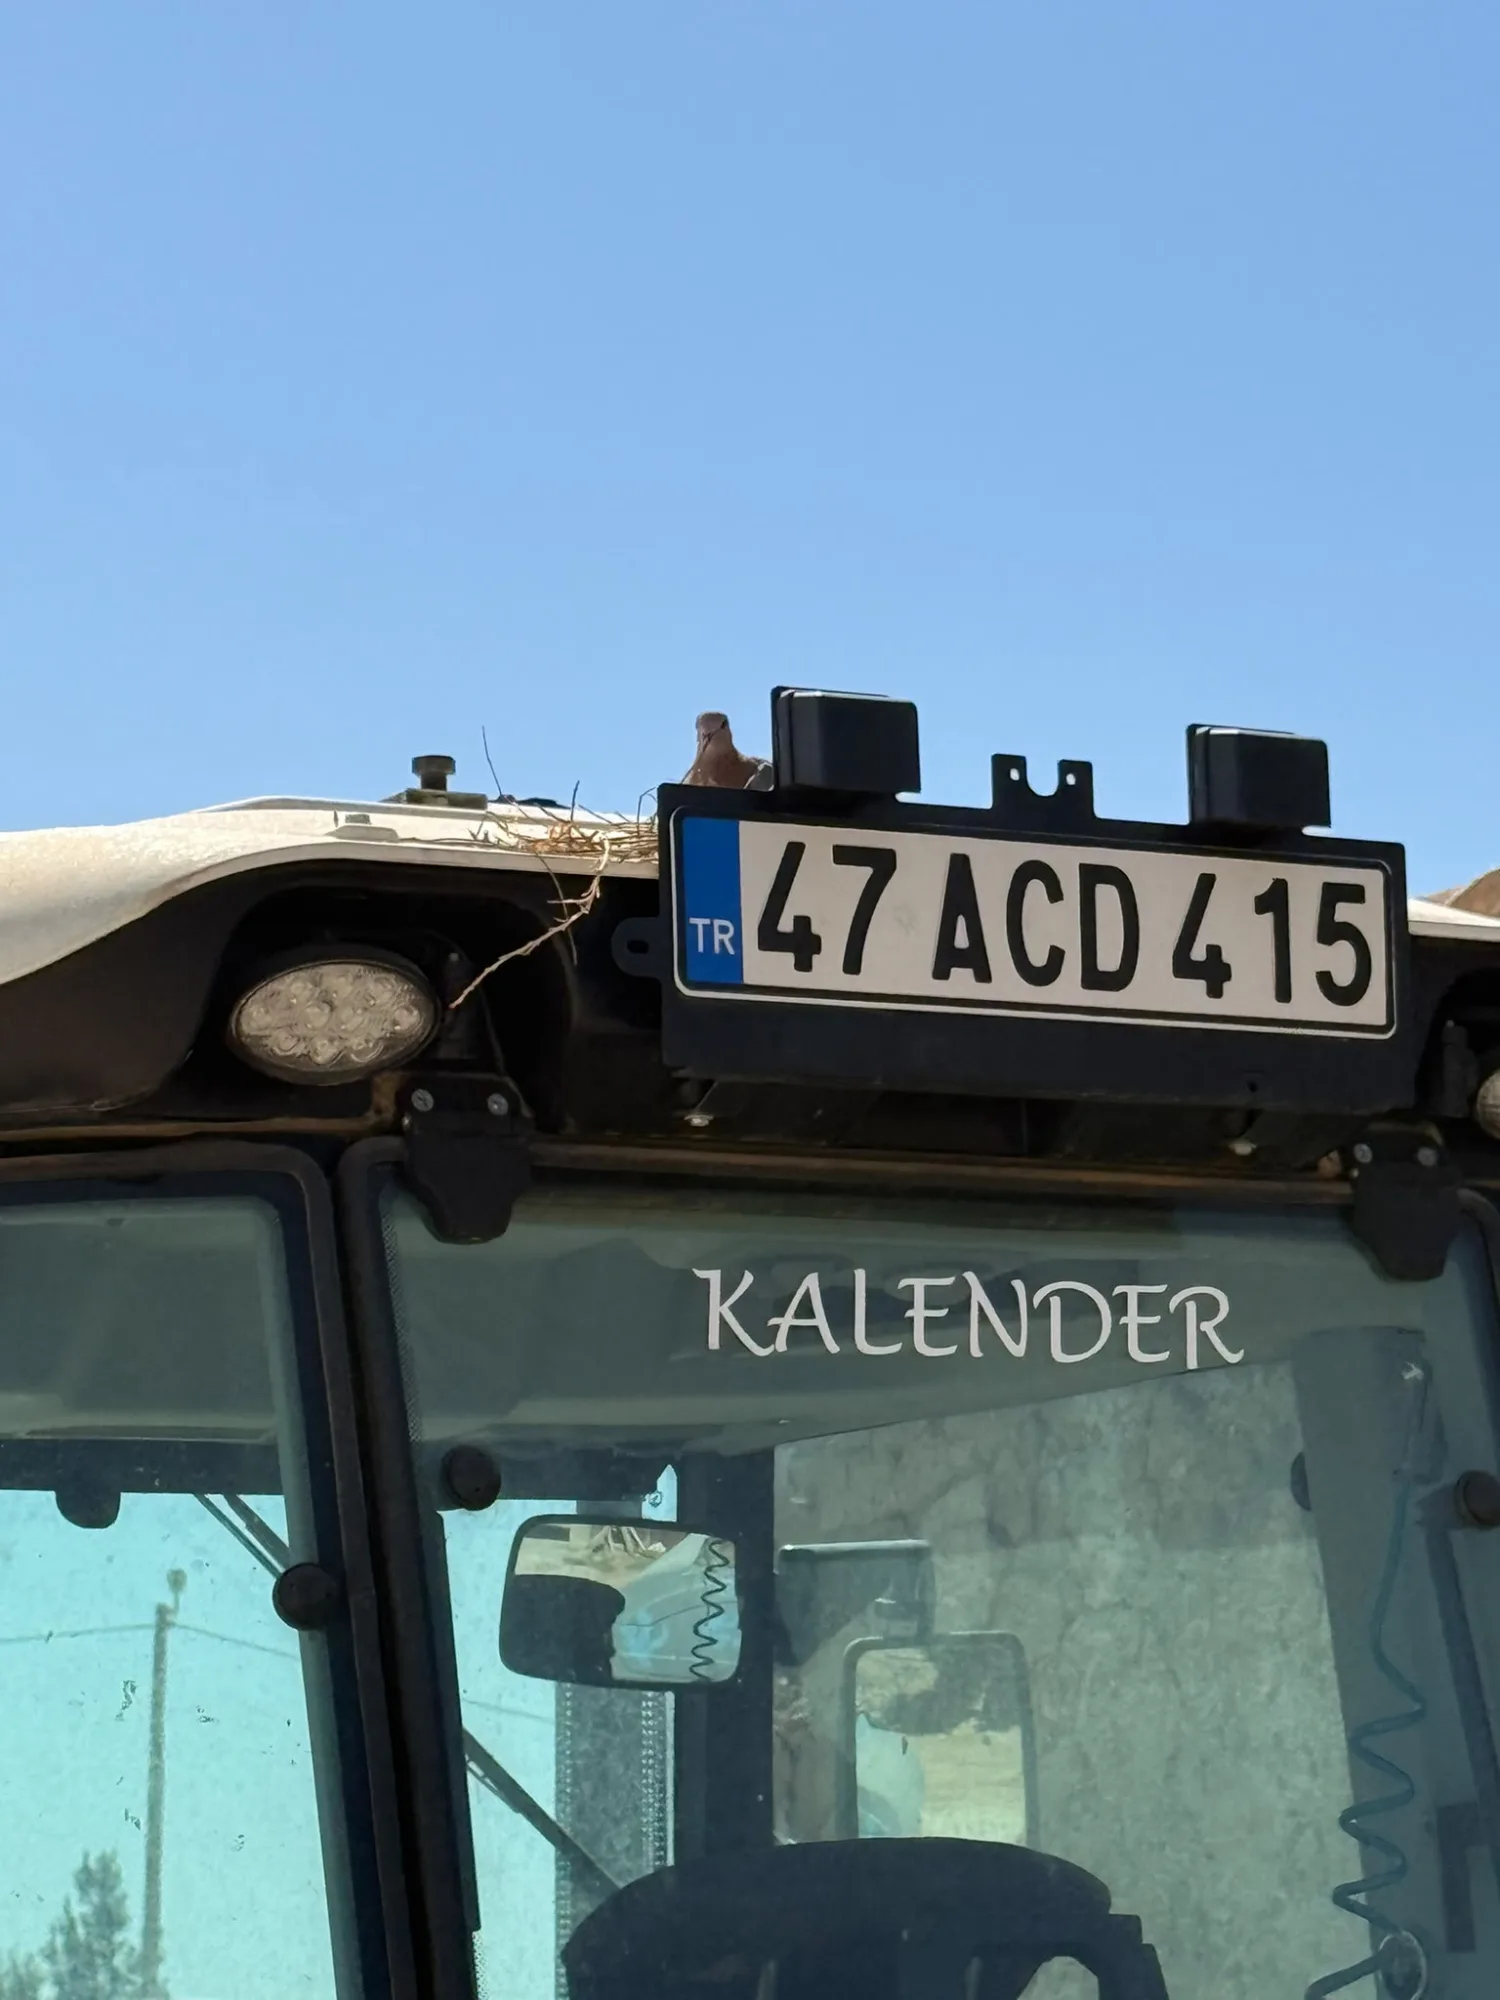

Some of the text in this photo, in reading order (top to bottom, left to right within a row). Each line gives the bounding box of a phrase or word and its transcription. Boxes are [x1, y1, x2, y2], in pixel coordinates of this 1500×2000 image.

[689, 841, 1373, 1007] TR 47 ACD 415
[692, 1268, 1245, 1370] KALENDER
